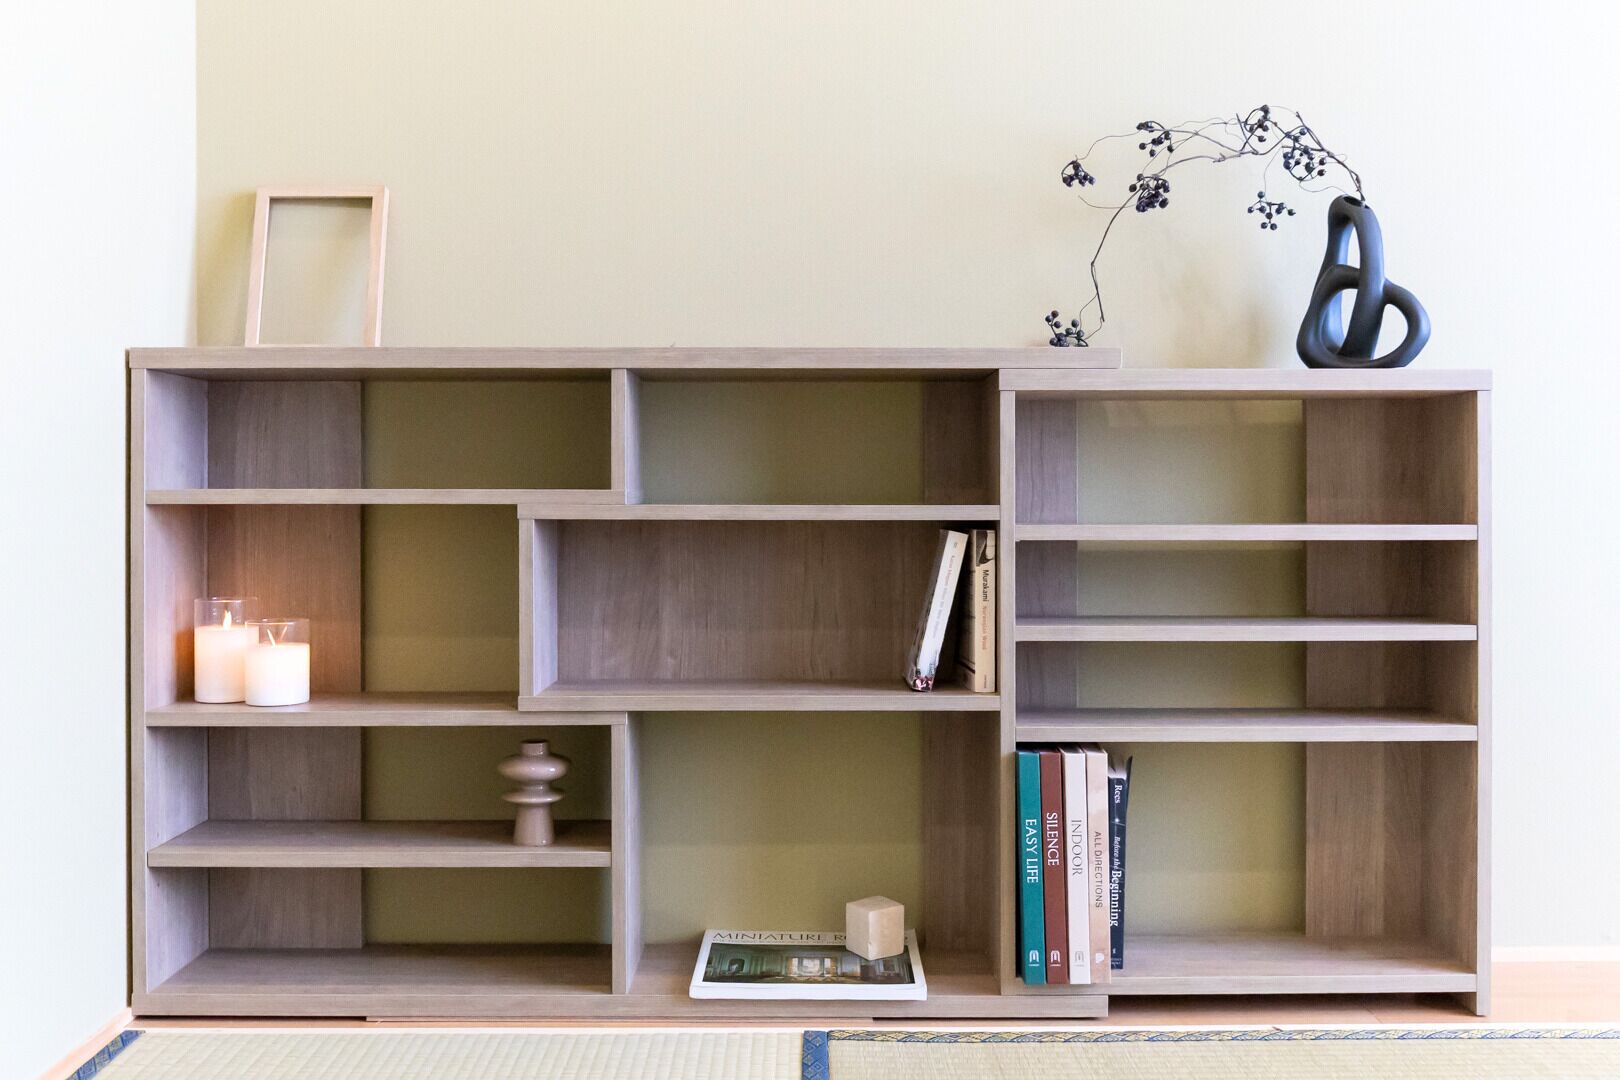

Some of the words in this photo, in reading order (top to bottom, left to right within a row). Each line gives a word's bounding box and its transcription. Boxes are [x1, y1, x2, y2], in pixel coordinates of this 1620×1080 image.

[982, 569, 990, 602] Murakami
[1114, 785, 1122, 804] Rees
[1025, 819, 1038, 854] EASY
[1046, 812, 1060, 866] SILENCE
[1071, 819, 1083, 876] INDOOR
[1094, 831, 1102, 848] ALL
[1113, 836, 1121, 857] Before
[1026, 858, 1039, 883] LIFE
[1113, 858, 1121, 870] the
[1094, 850, 1103, 908] DIRECTIONS
[1109, 870, 1122, 926] Beginning
[713, 932, 822, 941] MINIATURE
